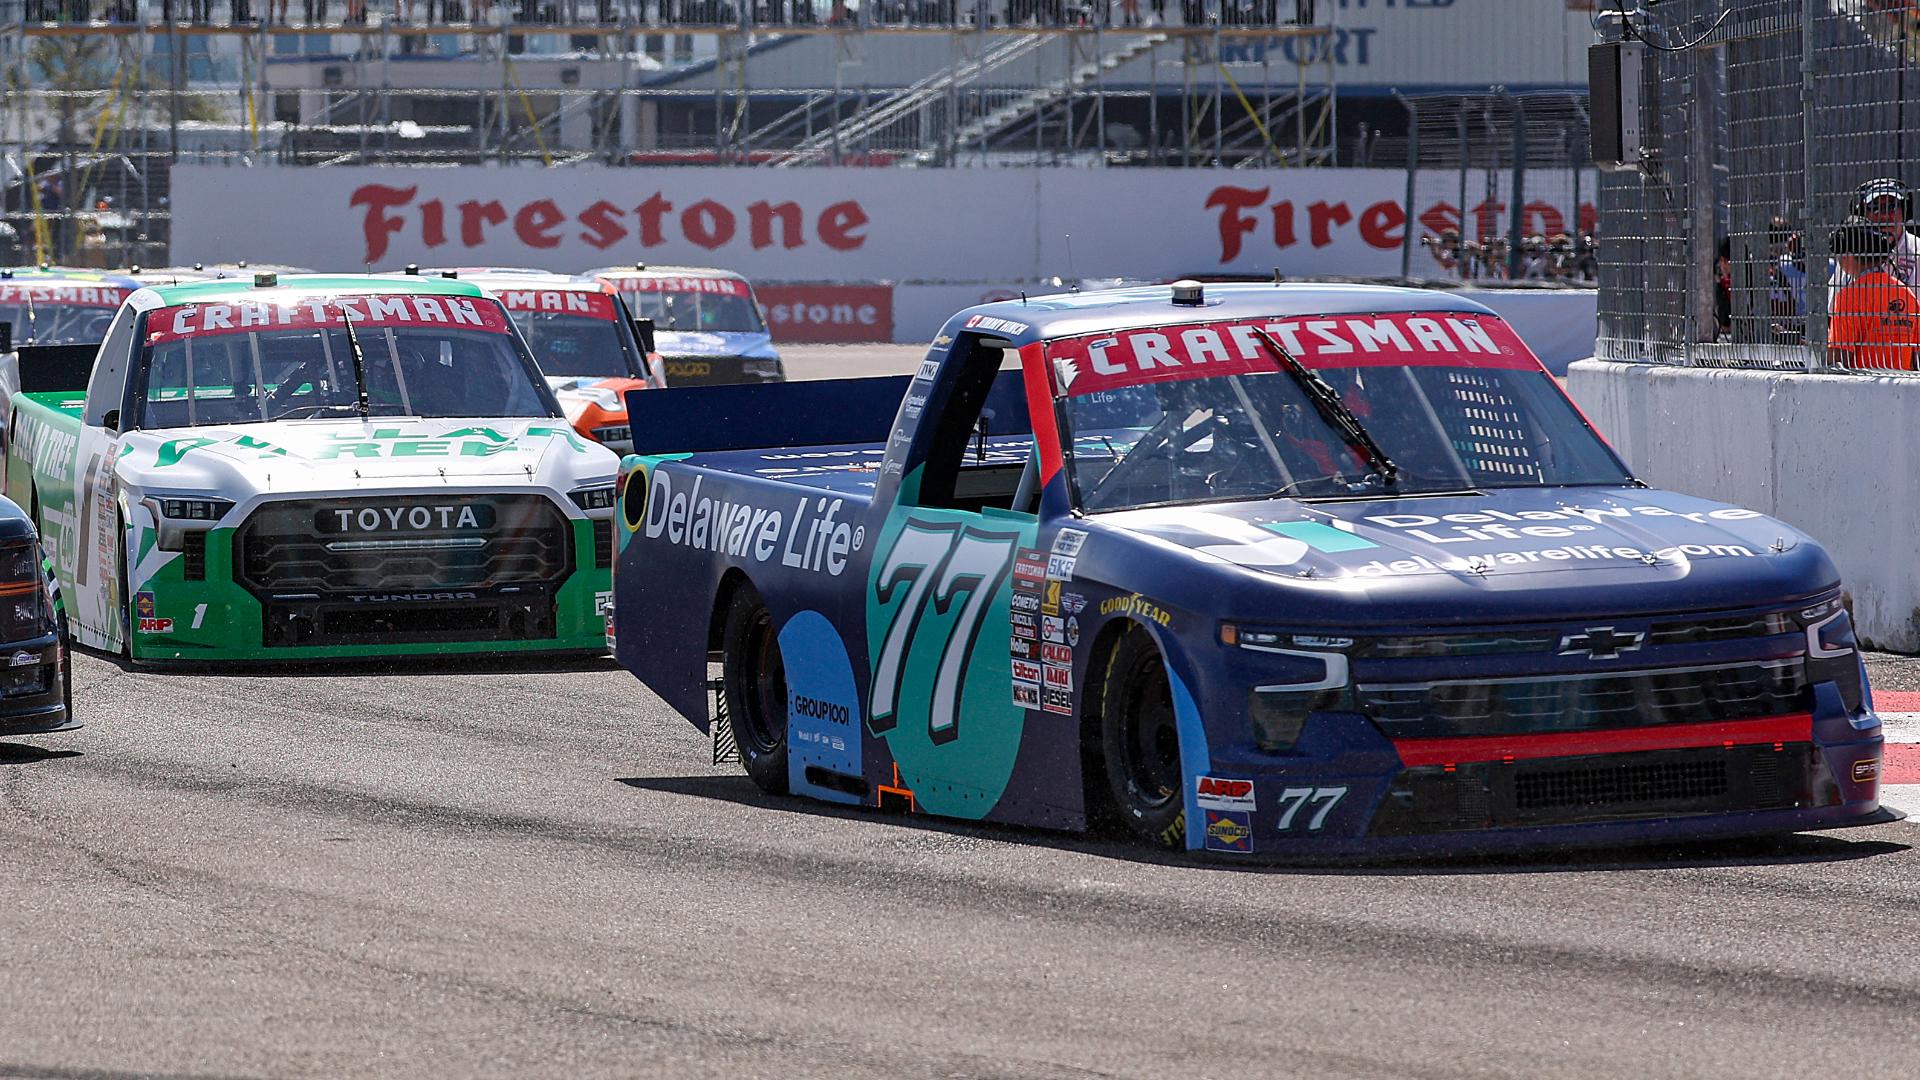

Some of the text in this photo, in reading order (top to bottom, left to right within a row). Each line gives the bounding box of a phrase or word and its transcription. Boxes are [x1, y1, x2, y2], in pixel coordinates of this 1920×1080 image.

[350, 183, 868, 264] Firestone
[172, 297, 485, 335] CRAFTSMAN
[1088, 318, 1502, 376] CRAFTSMAN
[334, 506, 479, 532] TOYOTA
[645, 469, 782, 562] Delaware
[1363, 504, 1763, 528] Delaware
[1047, 558, 1073, 577] SKF
[347, 591, 478, 603] TUNDRA
[1011, 594, 1039, 610] COMETIC
[139, 617, 173, 631] ARP
[190, 603, 209, 629] 1
[867, 517, 1020, 746] 77
[1042, 643, 1071, 663] CALICO
[1013, 661, 1041, 681] tilton
[1043, 689, 1072, 709] JESEL
[1198, 777, 1252, 797] ARP
[1277, 785, 1349, 832] 77
[1208, 825, 1249, 837] SUNOCO
